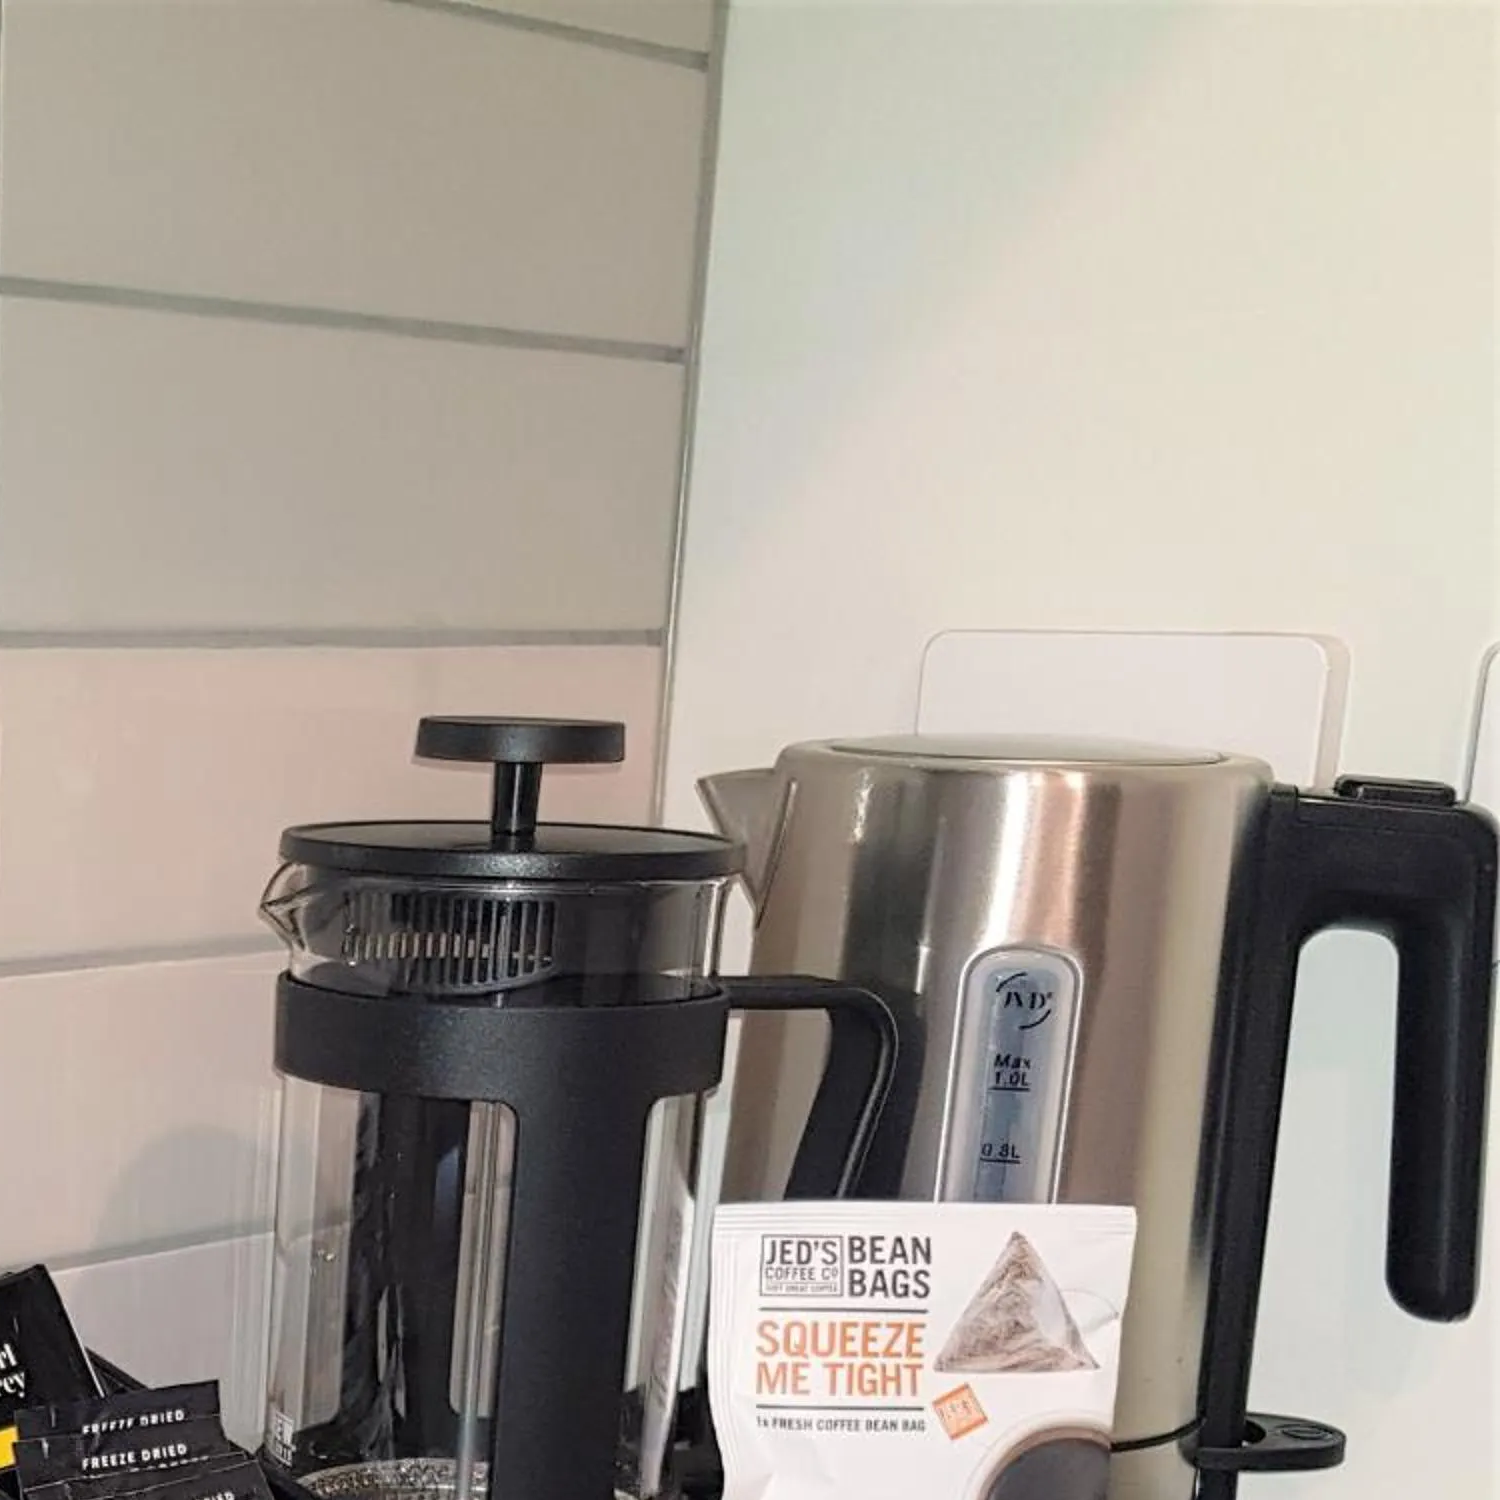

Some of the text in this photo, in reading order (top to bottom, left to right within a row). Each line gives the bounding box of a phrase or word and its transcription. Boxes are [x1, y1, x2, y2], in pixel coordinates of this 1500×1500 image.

[994, 1053, 1031, 1069] Max
[995, 1071, 1030, 1086] 1.0L
[766, 1240, 838, 1265] JED'S
[848, 1236, 932, 1265] BEAN
[765, 1266, 816, 1281] COFFEE
[848, 1269, 931, 1299] BAGS
[756, 1319, 927, 1360] SQUEEZE
[756, 1361, 924, 1397] ME TIGHT
[771, 1417, 813, 1431] FRESH
[816, 1418, 861, 1432] COFFEE
[865, 1418, 897, 1432] BEAN
[902, 1419, 926, 1433] BAG
[81, 1451, 137, 1470] FREEZE
[141, 1443, 187, 1461] DRIED
